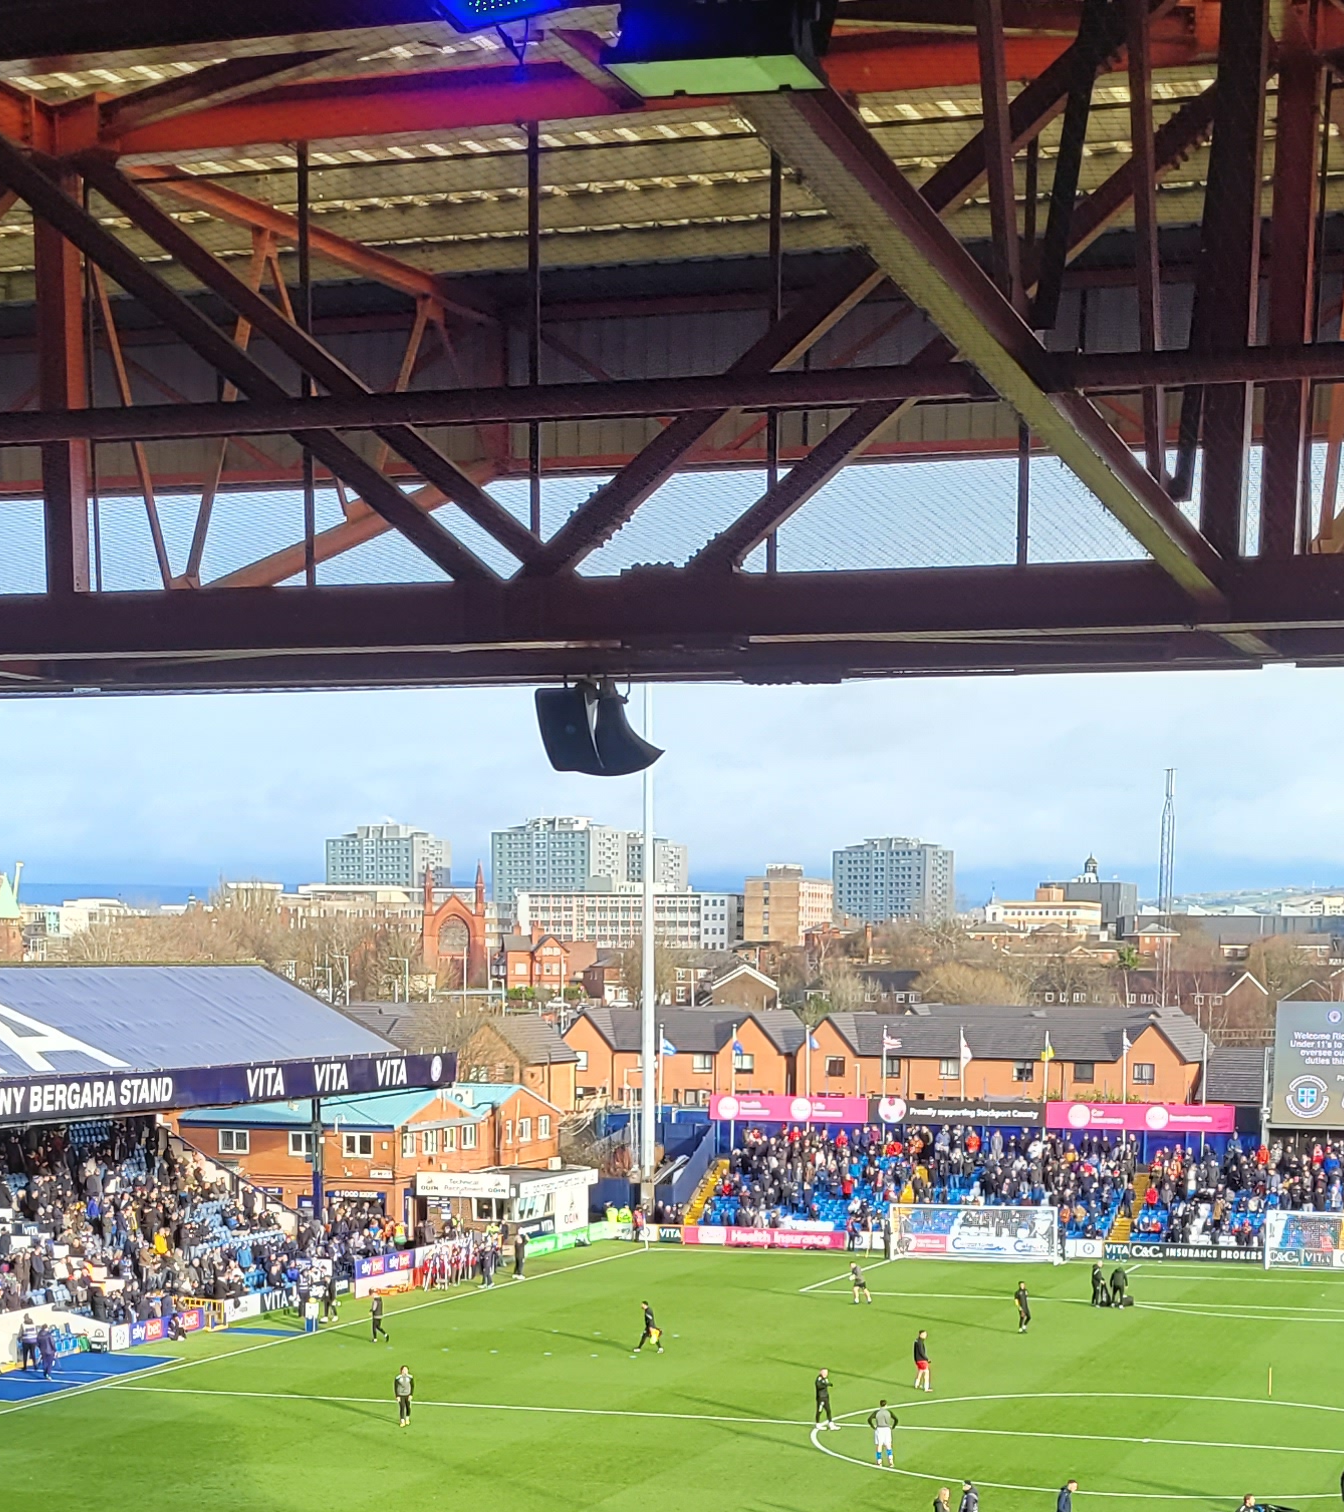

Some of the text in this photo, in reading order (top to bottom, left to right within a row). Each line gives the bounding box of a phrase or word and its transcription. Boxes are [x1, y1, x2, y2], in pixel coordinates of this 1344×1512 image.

[1294, 1032, 1330, 1040] Welcome
[1290, 1040, 1315, 1048] Under
[1305, 1057, 1330, 1065] duties
[313, 1062, 349, 1093] VITA
[375, 1058, 407, 1086] VITA
[246, 1066, 285, 1097] VITA
[29, 1081, 117, 1113] BERGARA
[120, 1076, 174, 1106] STAND
[909, 1107, 1039, 1119] Proudly supporting Stockport County
[659, 1228, 681, 1238] VITA
[732, 1229, 831, 1246] Health Insurance
[1105, 1244, 1129, 1254] VITA
[1166, 1248, 1217, 1259] INSURANCE
[1221, 1249, 1263, 1260] BROKERS
[361, 1261, 372, 1275] sky
[389, 1255, 399, 1269] sky
[263, 1290, 289, 1310] VITA
[132, 1324, 146, 1340] sky
[147, 1321, 162, 1335] bet
